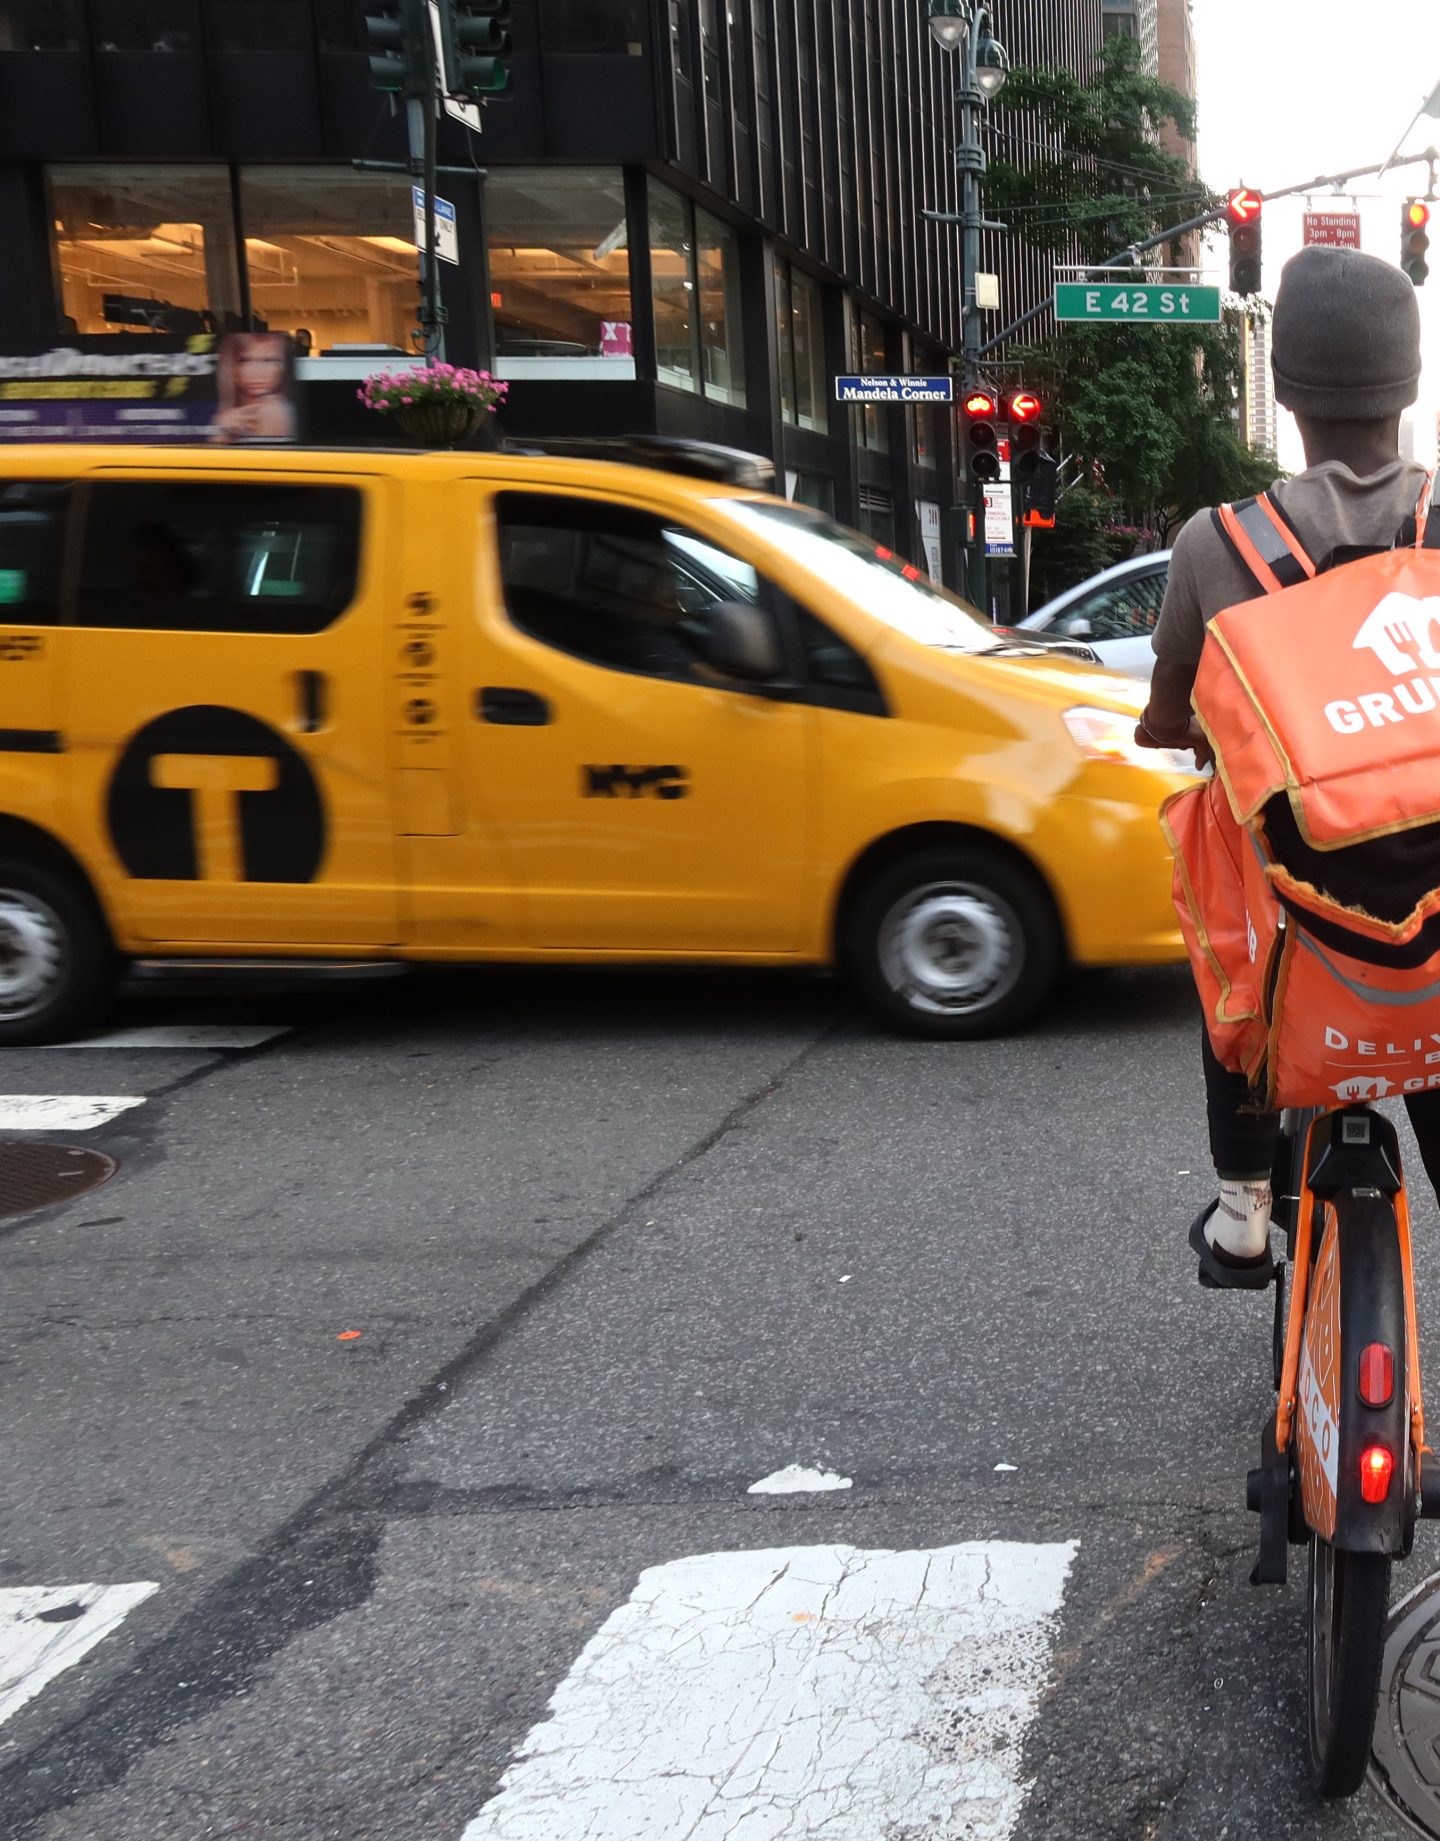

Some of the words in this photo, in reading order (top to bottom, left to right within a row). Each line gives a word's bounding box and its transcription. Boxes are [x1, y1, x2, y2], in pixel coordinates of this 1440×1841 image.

[1306, 216, 1318, 226] No
[1320, 215, 1357, 229] Standing
[1309, 228, 1328, 240] 3pm
[1336, 228, 1355, 240] 8pm
[1086, 291, 1101, 313] E
[1110, 291, 1149, 313] 42
[1159, 292, 1190, 314] St
[860, 378, 889, 387] Nelson
[889, 378, 898, 387] &
[898, 378, 928, 387] Winnie
[843, 386, 899, 400] Mandela
[901, 387, 947, 400] Corner
[580, 763, 691, 800] NYC
